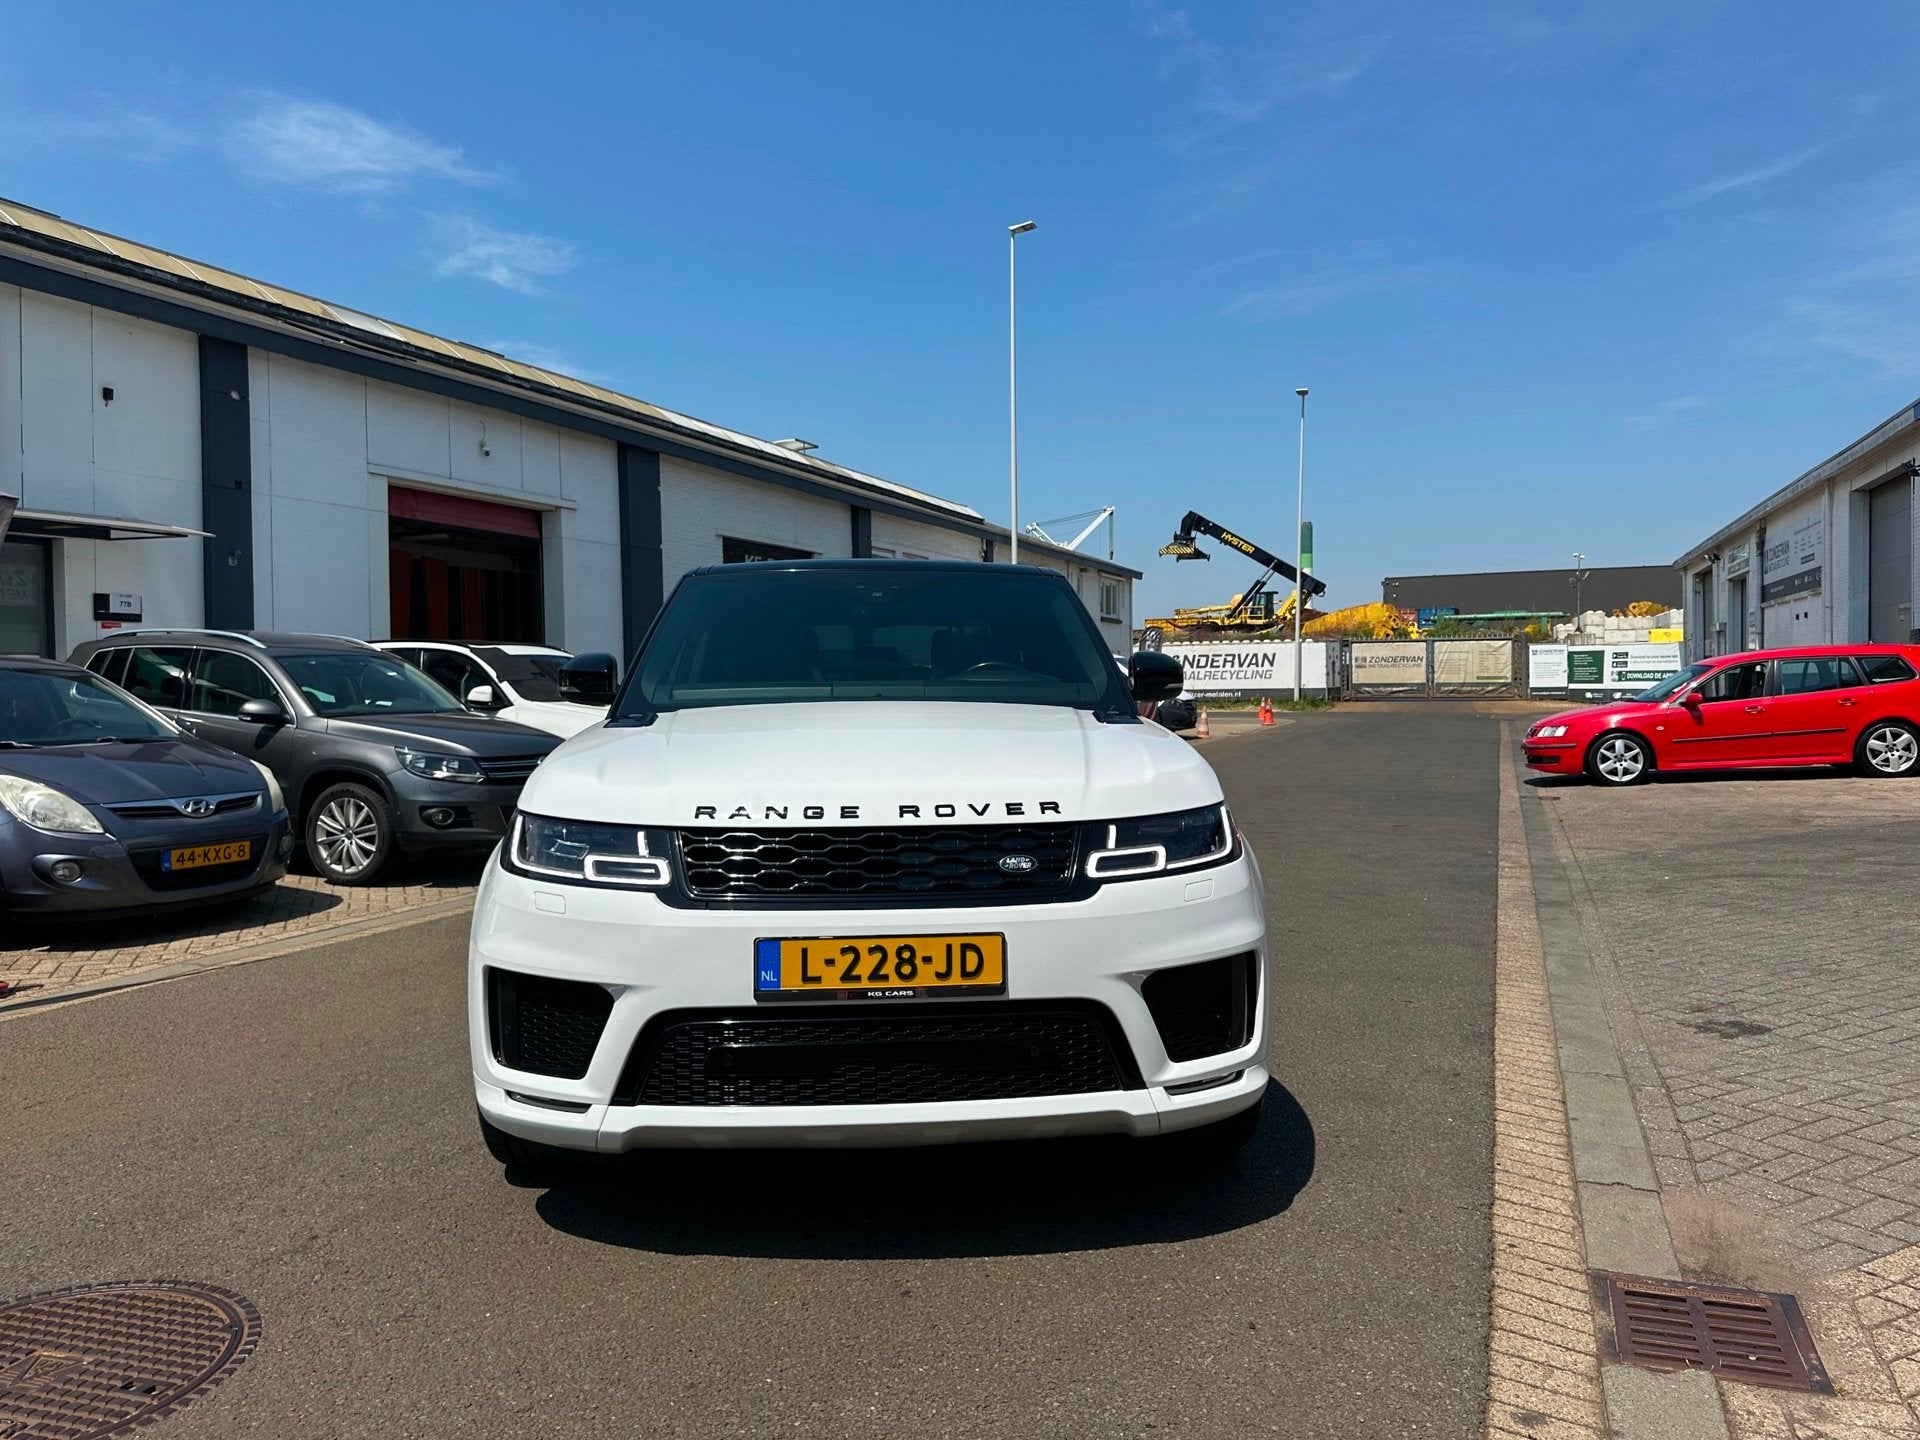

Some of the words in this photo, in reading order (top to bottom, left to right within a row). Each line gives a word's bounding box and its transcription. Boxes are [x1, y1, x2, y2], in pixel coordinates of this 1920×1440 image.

[1221, 531, 1256, 554] HYSTER
[1173, 652, 1276, 669] NDERVAN
[1368, 655, 1424, 663] ZONDERVAN
[1184, 669, 1273, 680] ALRECYCLING
[694, 805, 860, 820] RANGE
[899, 801, 1062, 819] ROVER
[176, 844, 246, 865] 44-KXG-8
[801, 942, 985, 984] L-228-JD
[761, 970, 777, 982] NL
